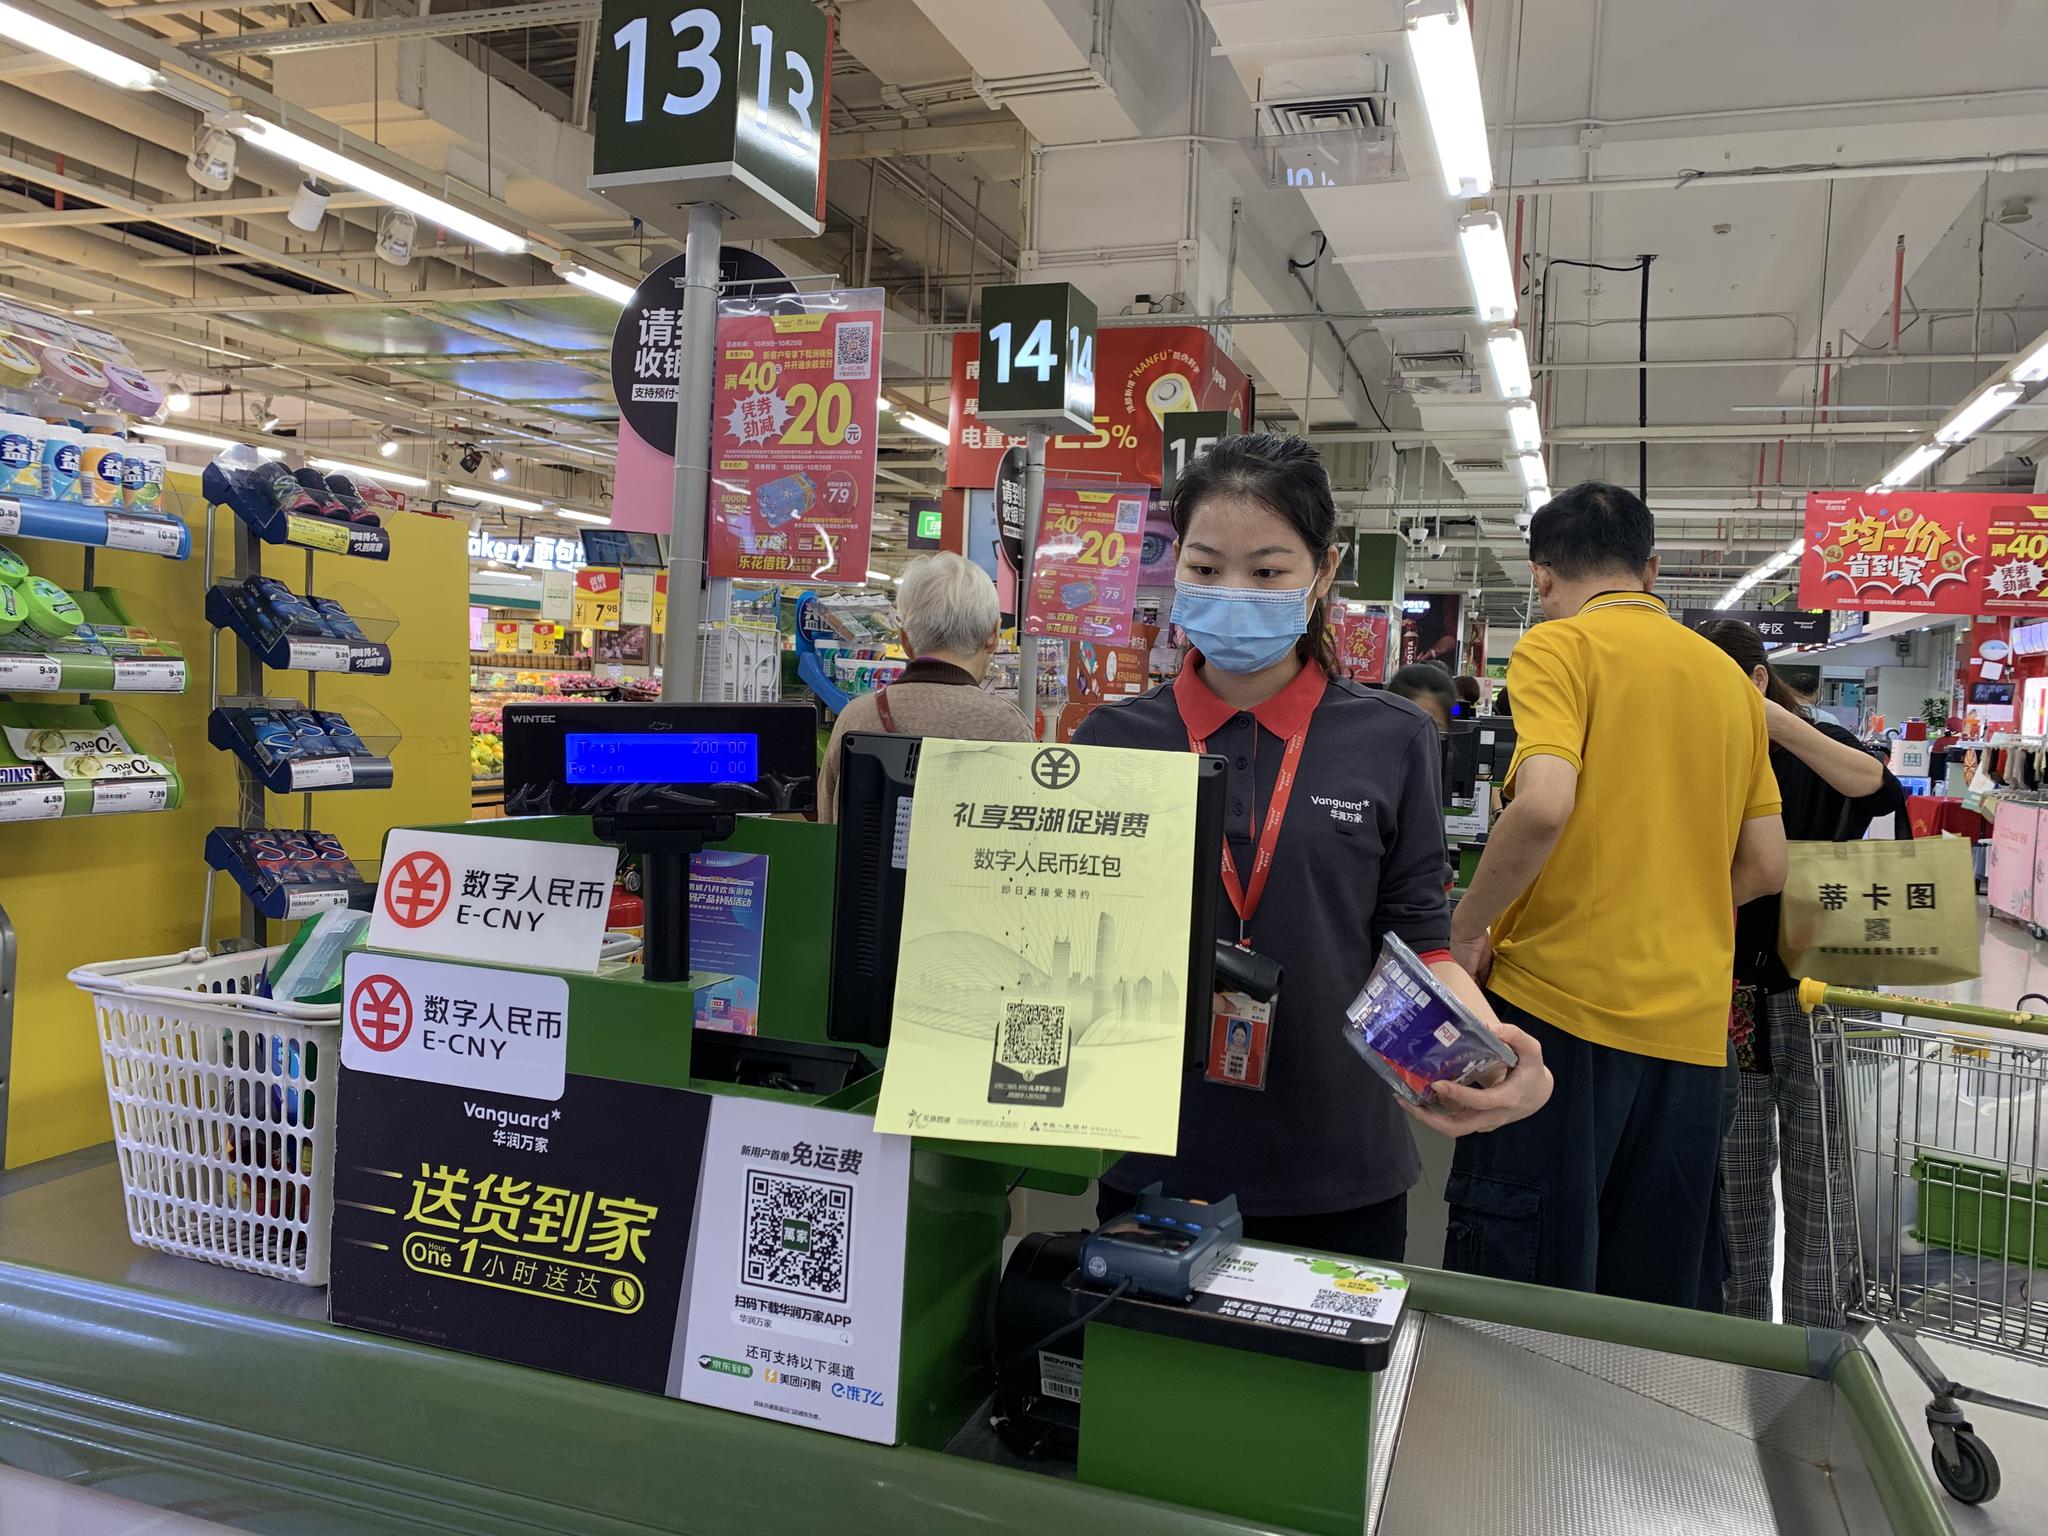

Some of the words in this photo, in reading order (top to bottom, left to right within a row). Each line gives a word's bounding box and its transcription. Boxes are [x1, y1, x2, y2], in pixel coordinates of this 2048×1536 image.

[613, 8, 722, 122] 13
[751, 25, 815, 157] 13
[989, 319, 1058, 383] 14
[634, 387, 679, 399] 支持预付
[1839, 515, 1953, 562] 均一价
[738, 555, 788, 570] 乐花借钱
[1844, 552, 1929, 586] 省到家
[1402, 600, 1430, 609] COSTA
[1758, 622, 1785, 635] 专区
[39, 666, 59, 675] 9.99
[512, 715, 556, 723] WINTEC
[43, 795, 63, 804] 4.59
[149, 790, 166, 799] 7.99
[1311, 795, 1362, 810] Vanguard
[953, 801, 1151, 838] 礼享罗湖促消费
[1330, 809, 1363, 823] 华润万家
[973, 847, 1123, 878] 数字人民币红包
[461, 869, 606, 910] 数字人民币
[1001, 884, 1091, 900] 即日起接受预约
[1818, 883, 1936, 912] 蒂卡图
[456, 904, 545, 932] E-CNY
[424, 995, 562, 1040] 数字人民币
[423, 1030, 508, 1060] E-CNY
[463, 1101, 551, 1130] Vanguard
[492, 1129, 550, 1155] 华润万家
[404, 1162, 659, 1264] 送货到家
[411, 1242, 452, 1268] One
[428, 1241, 447, 1252] Hour
[734, 1293, 852, 1329] 扫码下载华润万家APP
[738, 1313, 773, 1330] 华润万家
[711, 1359, 752, 1378] 京东到家
[745, 1344, 856, 1381] 还可支持以下渠道
[779, 1372, 822, 1393] 美团闪购
[846, 1385, 884, 1407] 饿了么
